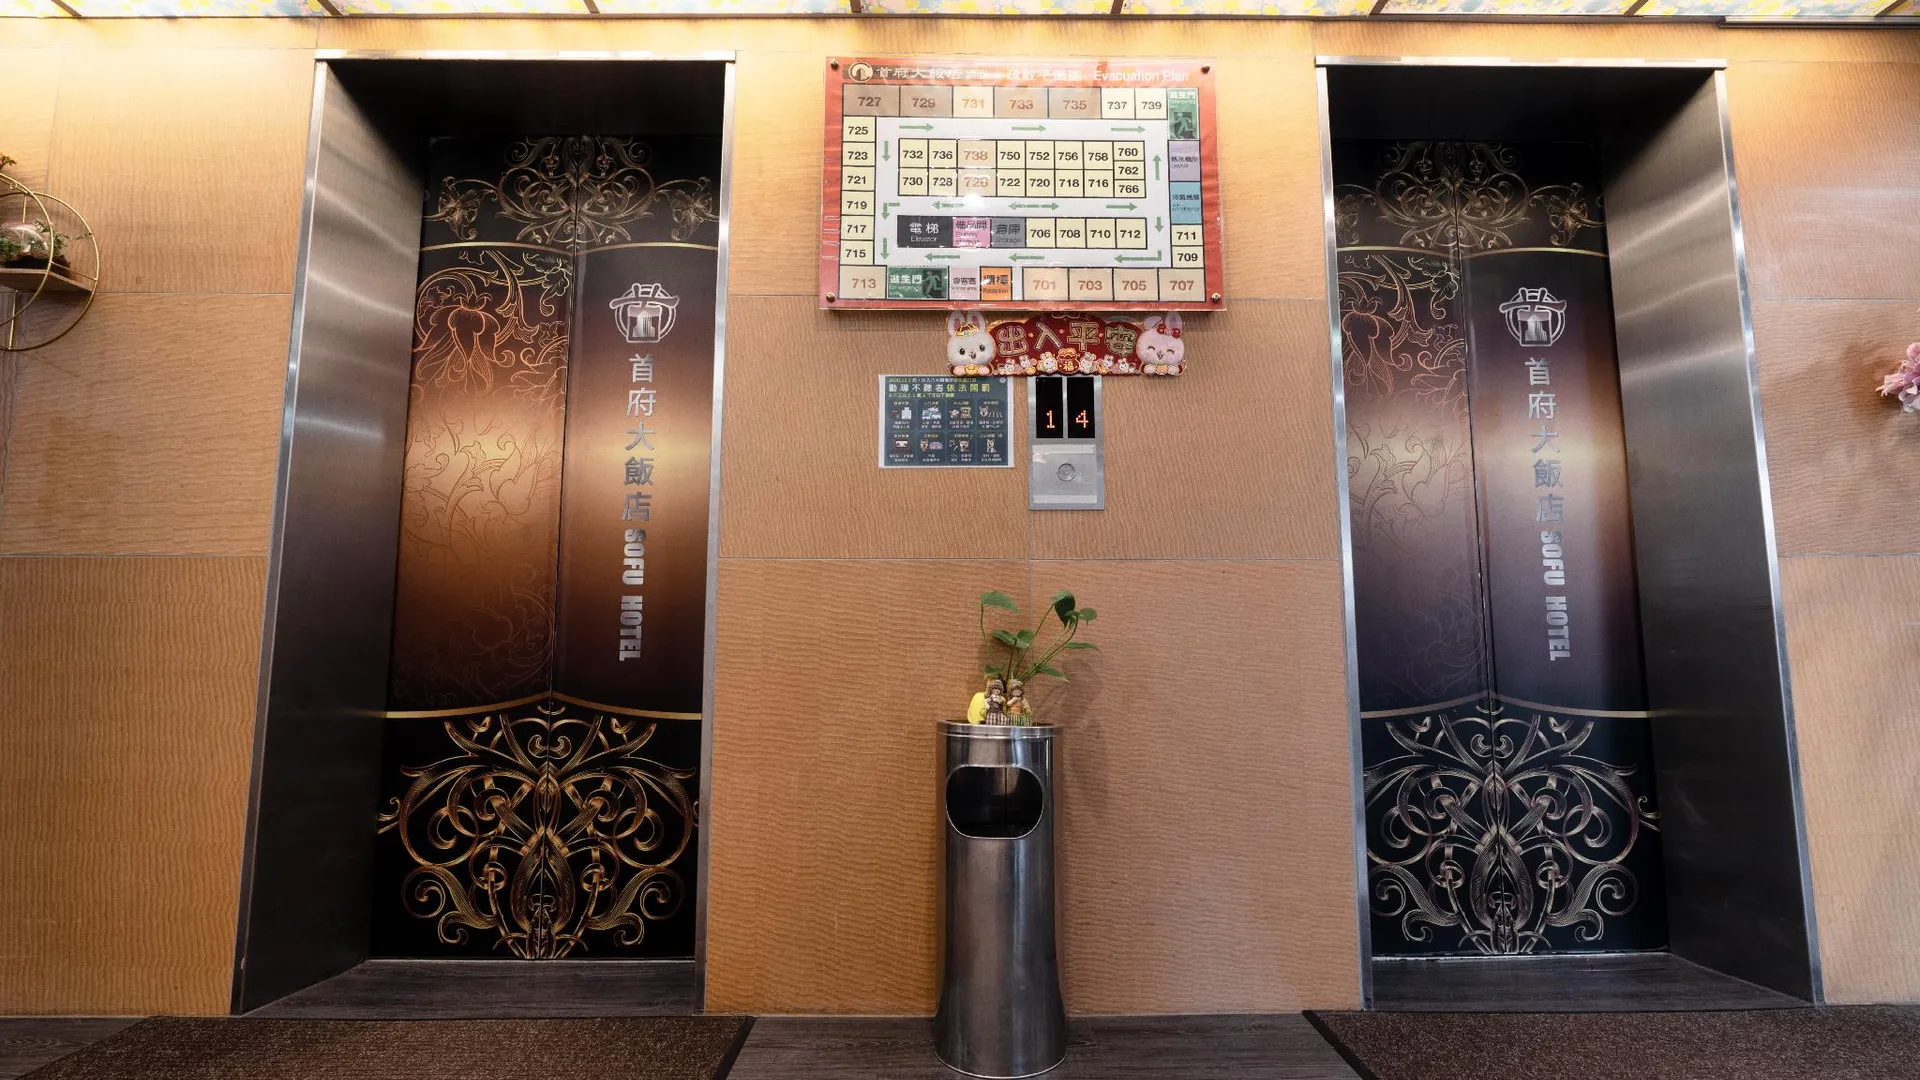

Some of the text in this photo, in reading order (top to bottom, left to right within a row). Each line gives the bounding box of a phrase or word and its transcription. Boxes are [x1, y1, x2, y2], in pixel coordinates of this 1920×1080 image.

[1093, 71, 1188, 82] Evacuation Plan
[858, 96, 882, 107] 727
[912, 97, 936, 108] 729
[962, 98, 985, 109] 731
[1010, 99, 1034, 110] 733
[1062, 99, 1087, 110] 735
[1107, 101, 1128, 110] 737
[1141, 101, 1162, 110] 739
[848, 126, 869, 135] 725
[847, 151, 868, 160] 723
[902, 150, 923, 159] 732
[932, 150, 953, 160] 736
[963, 150, 988, 160] 738
[1000, 151, 1021, 160] 750
[1029, 151, 1050, 161] 752
[1058, 151, 1079, 161] 756
[1088, 152, 1109, 162] 758
[1118, 147, 1138, 157] 760
[1118, 166, 1139, 175] 762
[847, 175, 867, 185] 721
[902, 177, 923, 186] 730
[932, 177, 953, 187] 728
[1000, 178, 1021, 187] 722
[1029, 178, 1051, 188] 720
[1059, 178, 1080, 188] 718
[1088, 178, 1109, 188] 716
[1118, 184, 1139, 194] 766
[846, 200, 868, 210] 719
[847, 224, 867, 234] 717
[909, 222, 940, 235] 電梯
[995, 223, 1021, 235] 倉庫
[1030, 229, 1051, 239] 706
[1060, 229, 1081, 239] 708
[1090, 230, 1111, 239] 710
[1120, 230, 1141, 239] 712
[1176, 231, 1197, 240] 711
[845, 249, 866, 258] 715
[1177, 252, 1198, 262] 709
[851, 278, 877, 289] 713
[1032, 279, 1056, 291] 701
[1078, 280, 1103, 291] 703
[1122, 280, 1147, 291] 705
[1169, 280, 1195, 291] 707
[997, 321, 1138, 357] 出入平安
[1063, 361, 1075, 371] 福
[1046, 410, 1055, 428] 1
[1075, 410, 1089, 428] 4
[621, 353, 657, 522] 首府大飯店
[1524, 357, 1565, 524] 首府大飯店
[619, 528, 647, 662] SOFU HOTEL
[1540, 530, 1571, 661] SOFU HOTEL
